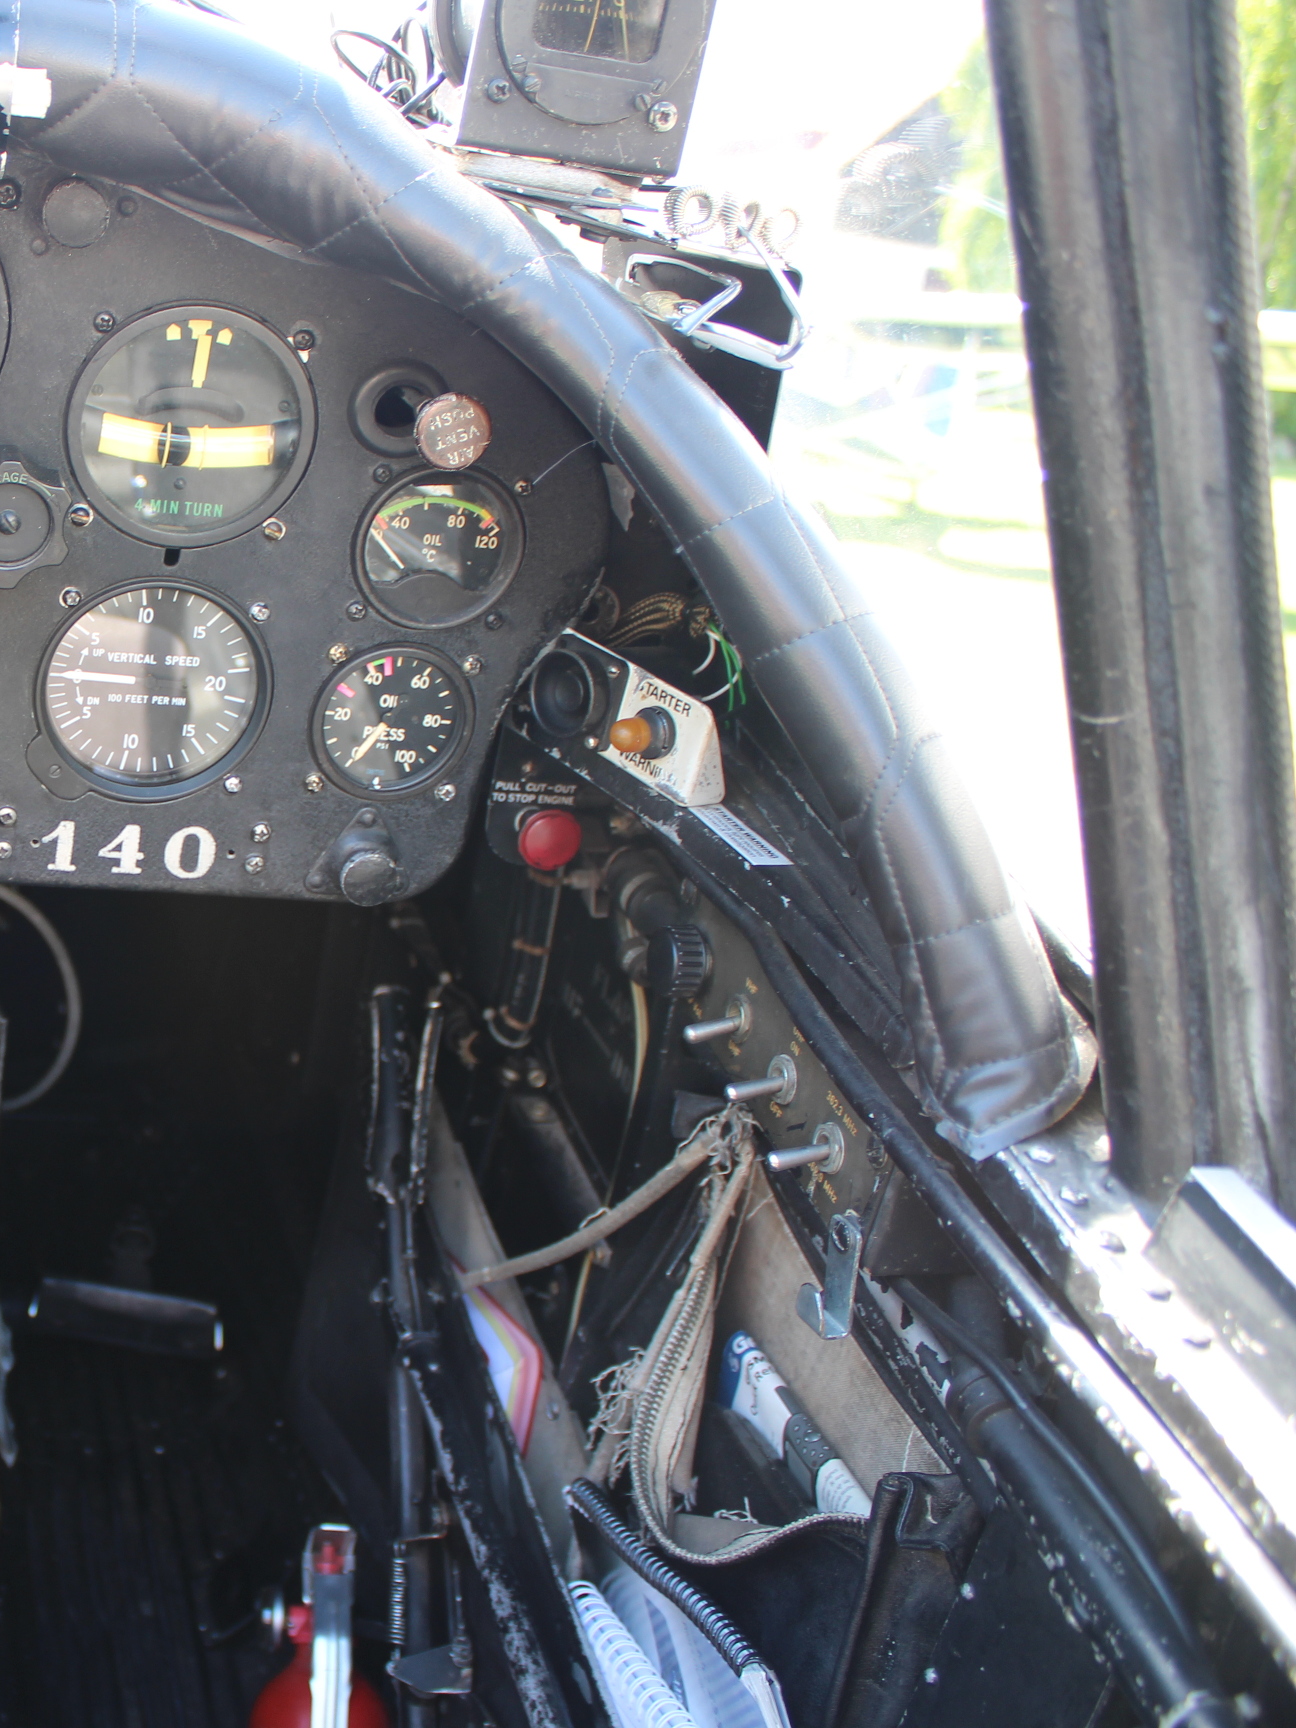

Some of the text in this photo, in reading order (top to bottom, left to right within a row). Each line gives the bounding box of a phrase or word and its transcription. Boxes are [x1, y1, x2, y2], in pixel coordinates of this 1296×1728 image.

[429, 408, 475, 430] PUSH
[435, 425, 480, 450] VENT
[447, 446, 474, 465] AIR
[134, 498, 223, 518] 4 MIN TURN
[392, 516, 410, 529] 40
[447, 515, 466, 528] 80
[423, 534, 442, 546] OIL
[475, 536, 498, 549] 120
[138, 608, 154, 624] 10
[193, 626, 206, 639] 15
[91, 633, 100, 646] 5
[92, 649, 105, 657] UP
[107, 652, 200, 667] VERTICAL SPEED
[204, 676, 226, 692] 20
[364, 672, 382, 686] 40
[410, 675, 430, 688] 60
[87, 696, 99, 705] DN
[108, 694, 186, 706] 100 FEET PER MIN
[640, 681, 691, 717] TARTER
[82, 707, 91, 719] 5
[334, 708, 351, 721] 20
[422, 714, 440, 728] 80
[182, 724, 196, 736] 15
[363, 725, 405, 742] PESS
[124, 734, 138, 749] 10
[394, 750, 416, 764] 100
[495, 781, 521, 791] PULL
[492, 792, 575, 805] TO STOP ENGINE
[41, 820, 217, 879] 140
